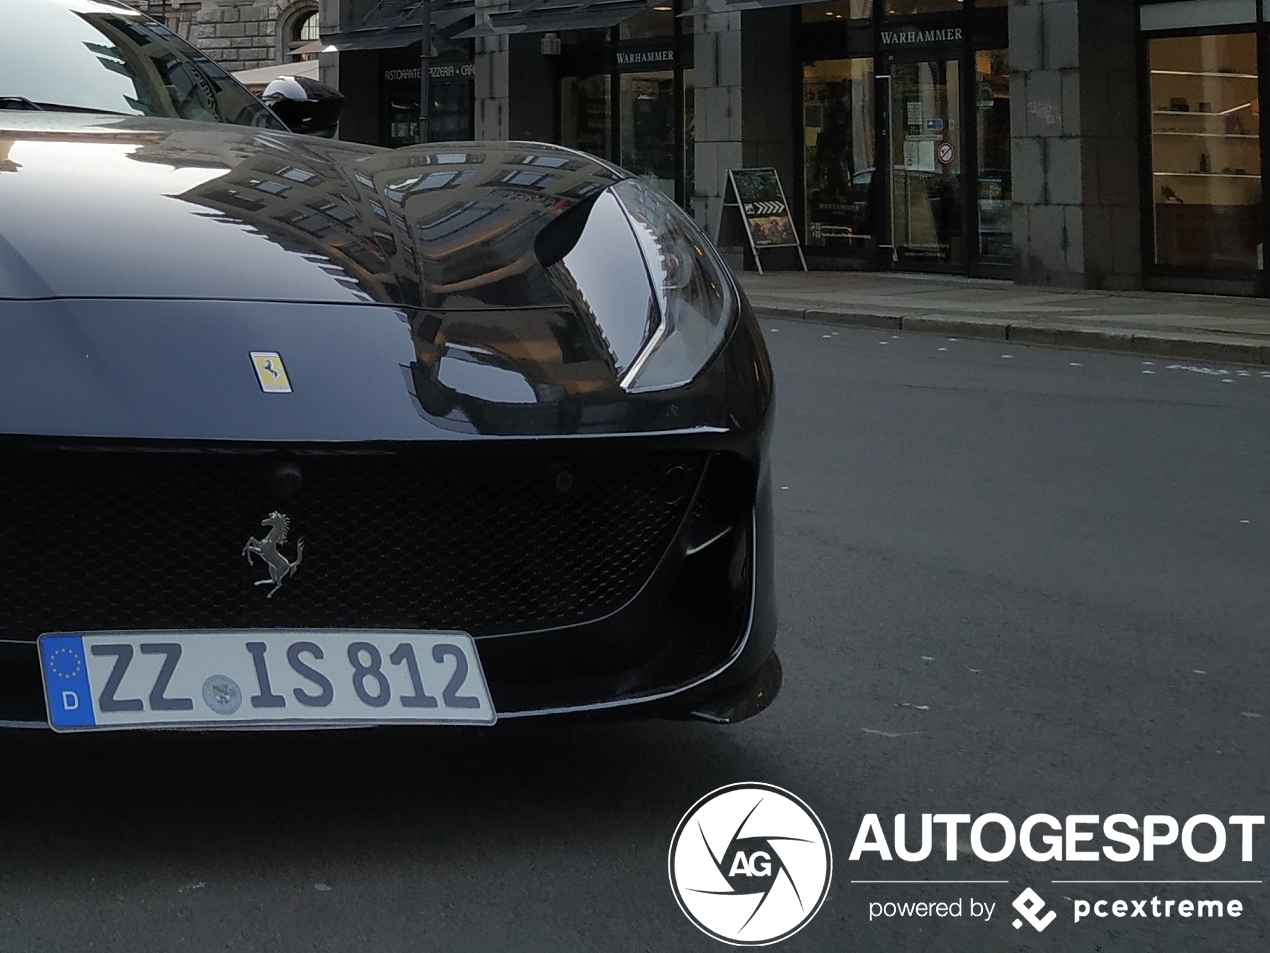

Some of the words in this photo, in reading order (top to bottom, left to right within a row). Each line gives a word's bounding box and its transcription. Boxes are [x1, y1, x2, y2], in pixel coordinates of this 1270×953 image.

[880, 28, 963, 45] WARHAMMER
[616, 50, 674, 64] WARHAMMER
[384, 67, 421, 81] RISTORANTE
[91, 642, 194, 712] ZZ
[61, 690, 80, 711] D
